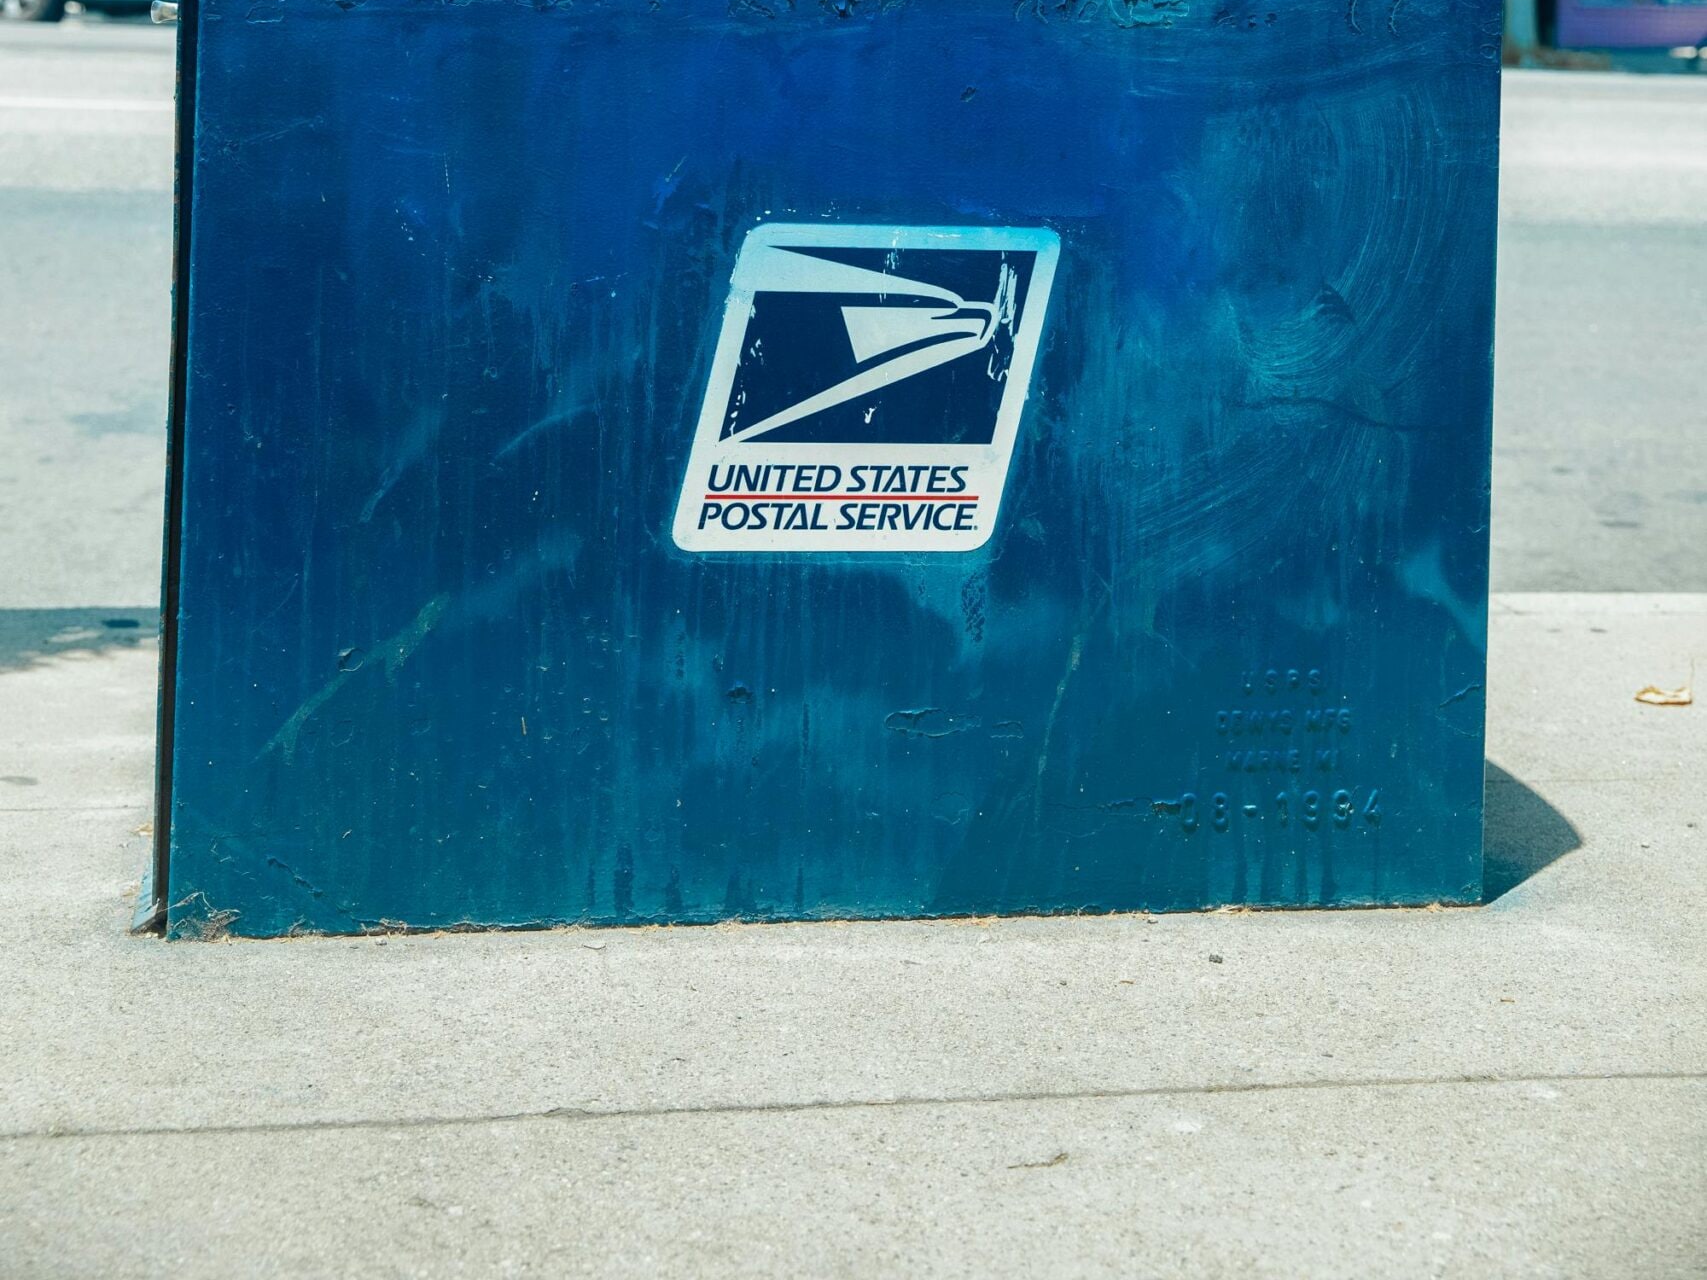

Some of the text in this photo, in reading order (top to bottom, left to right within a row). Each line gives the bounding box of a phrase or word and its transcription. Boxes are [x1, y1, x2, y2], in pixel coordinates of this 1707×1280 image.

[705, 464, 969, 494] UNITED STATES
[697, 502, 829, 531] POSTAL
[1240, 668, 1321, 695] USPS
